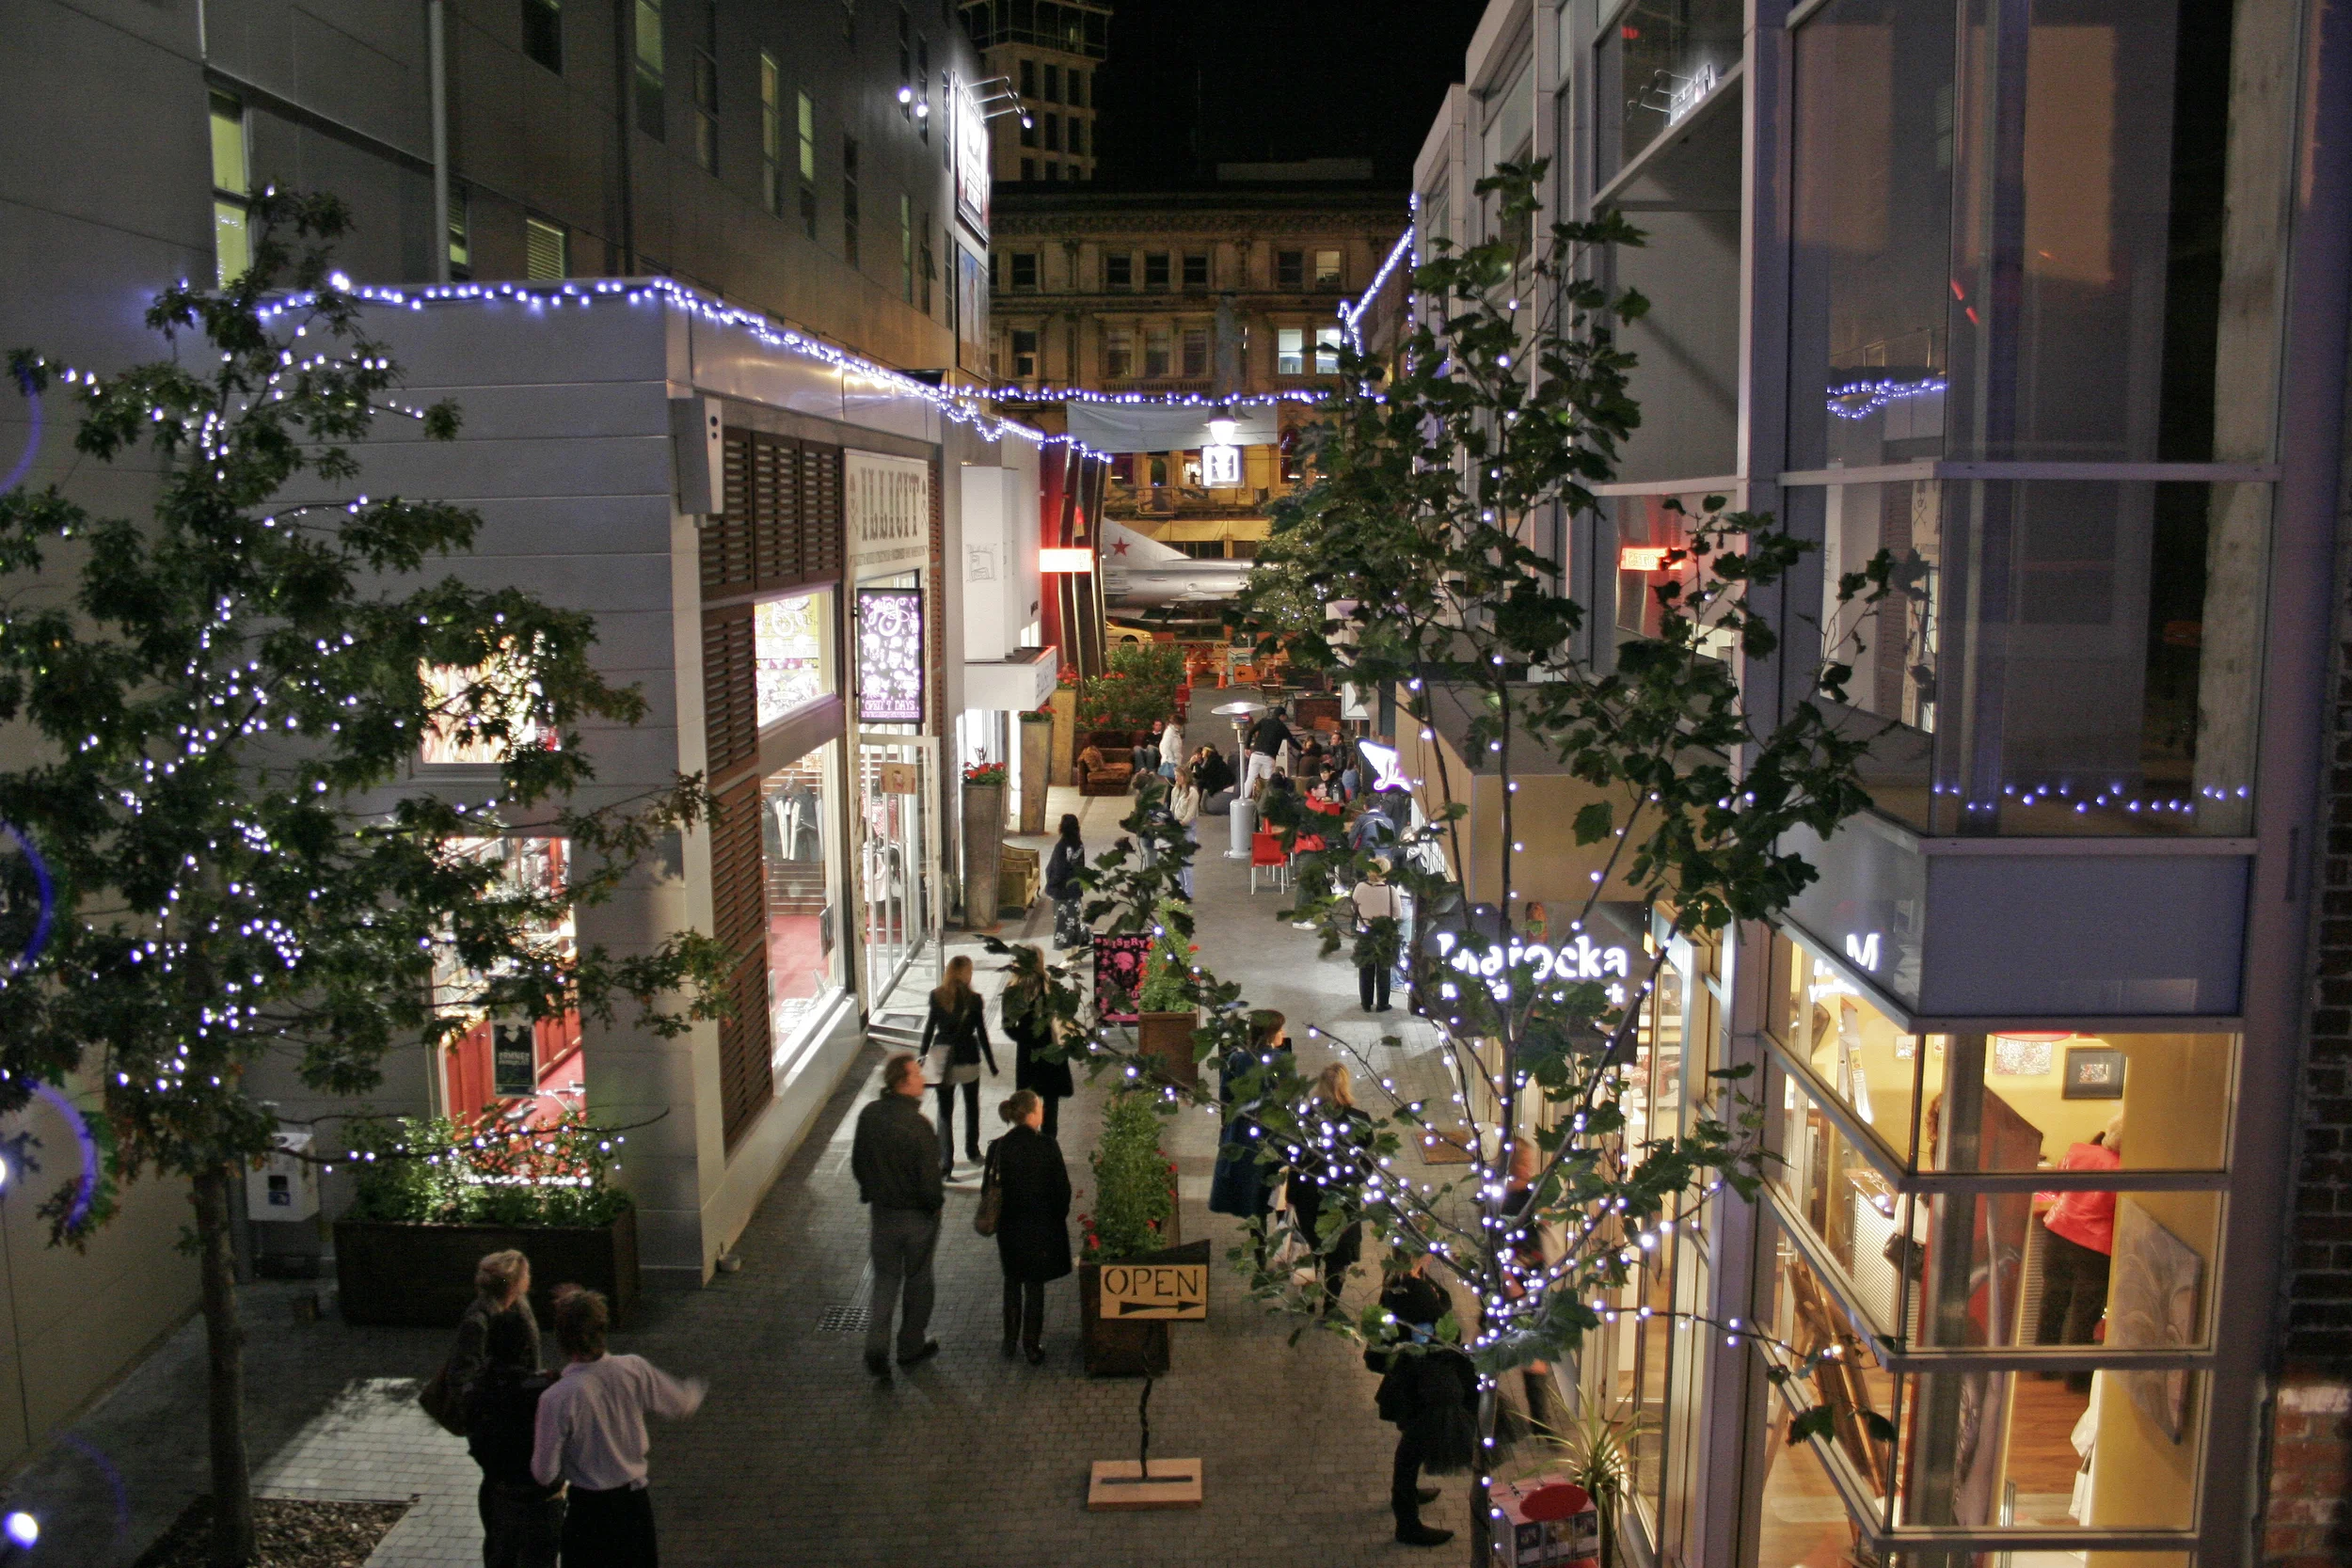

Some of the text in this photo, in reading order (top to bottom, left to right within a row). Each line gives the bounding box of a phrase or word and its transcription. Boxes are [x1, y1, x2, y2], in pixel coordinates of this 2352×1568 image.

[860, 467, 920, 542] ILLICIT
[895, 700, 915, 710] DAYS
[1104, 1267, 1199, 1297] OPEN
